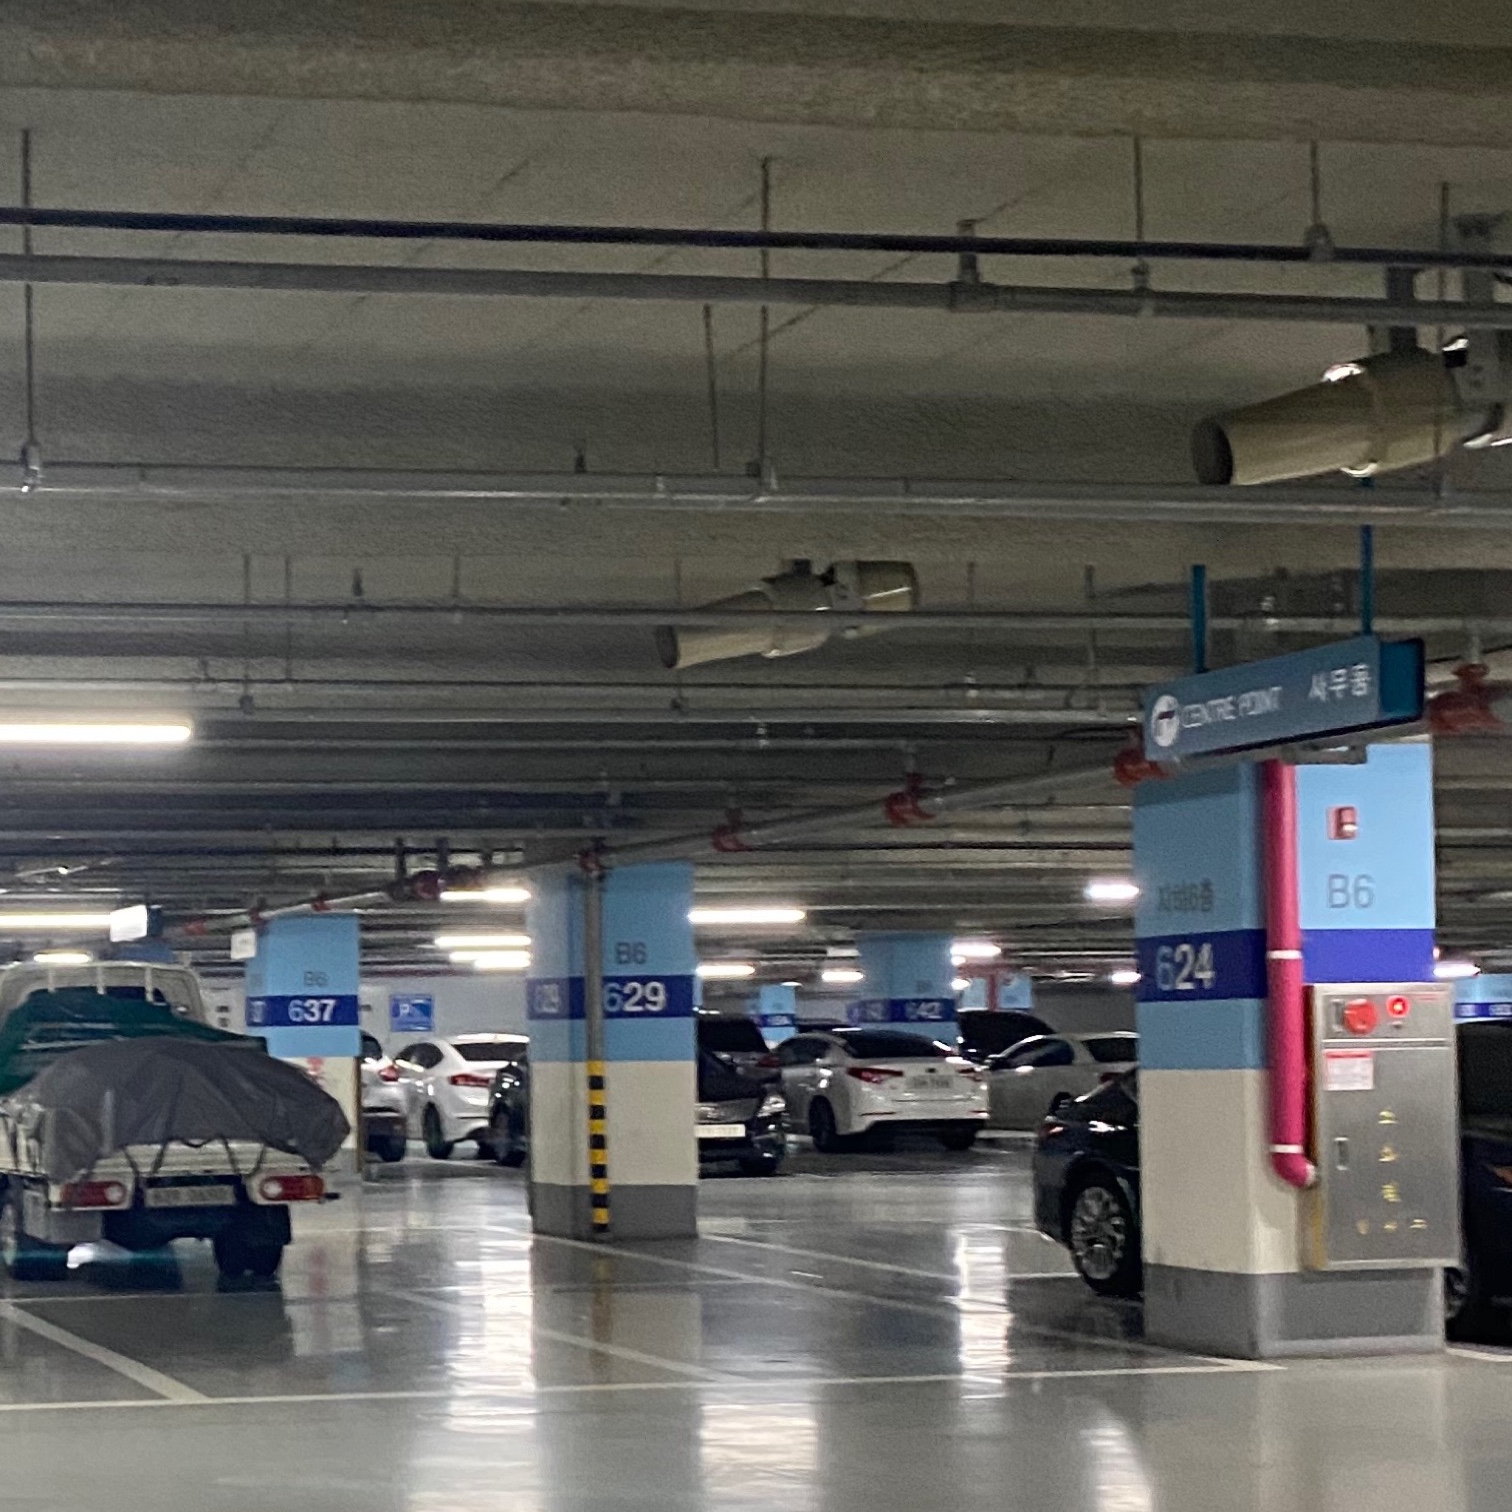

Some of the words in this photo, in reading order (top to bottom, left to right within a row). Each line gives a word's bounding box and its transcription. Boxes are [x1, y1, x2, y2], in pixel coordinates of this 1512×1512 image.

[1181, 696, 1236, 728] CENTRE
[1238, 686, 1283, 716] POINT
[1326, 873, 1376, 909] B6
[615, 941, 648, 965] B6
[1155, 942, 1216, 991] 624
[303, 970, 329, 988] B6
[288, 999, 337, 1023] 637
[603, 980, 667, 1013] 629
